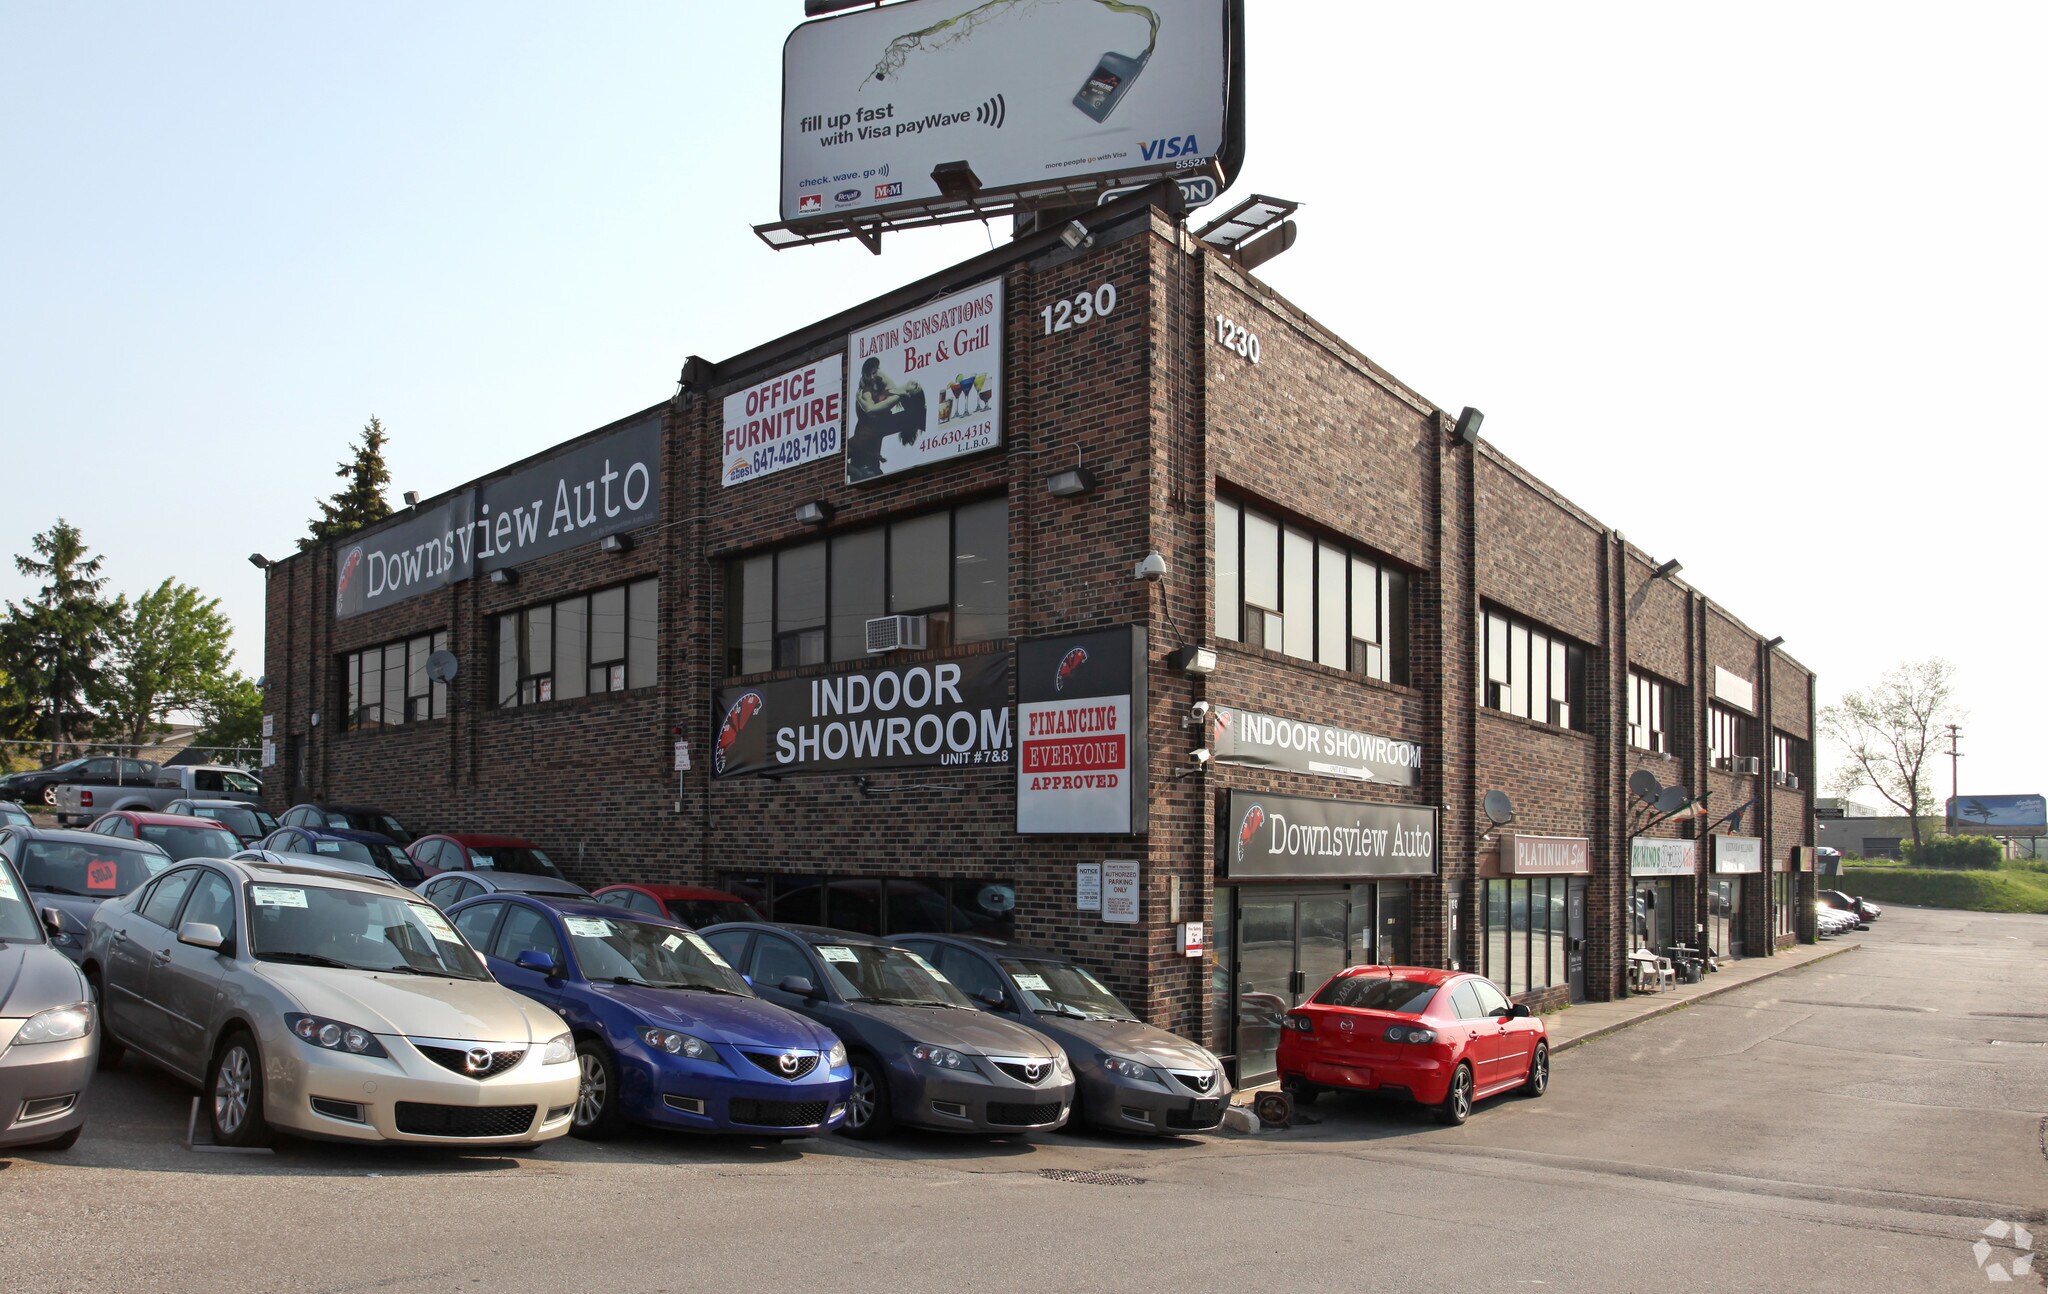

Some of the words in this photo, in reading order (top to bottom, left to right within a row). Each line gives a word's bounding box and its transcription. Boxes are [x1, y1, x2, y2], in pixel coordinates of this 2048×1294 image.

[800, 115, 822, 133] fill
[827, 113, 850, 130] up
[856, 103, 894, 123] fast
[820, 130, 853, 147] with
[857, 126, 891, 141] Visa
[896, 110, 971, 137] payWave
[1045, 161, 1062, 169] more
[1063, 157, 1086, 168] people
[1087, 156, 1096, 164] go
[1097, 153, 1112, 161] with
[1136, 134, 1199, 161] VISA
[1175, 158, 1207, 169] 5552A
[799, 176, 831, 188] check.
[833, 172, 860, 182] wave.
[863, 168, 876, 178] go
[859, 327, 899, 359] LATIN
[903, 293, 993, 344] SENSATIONS
[1040, 283, 1117, 335] 1230
[903, 347, 932, 373] Bar
[935, 339, 950, 363] &
[953, 324, 990, 356] Grill
[1215, 313, 1260, 364] 1230
[745, 368, 816, 417] OFFICE
[725, 393, 839, 456] FURNITURE
[919, 420, 992, 452] 416.630.4318
[753, 426, 837, 474] 647-428-7189
[367, 503, 543, 598] Downsview
[548, 459, 650, 538] Auto
[811, 663, 963, 717] INDOOR
[776, 706, 1013, 764] SHOWROOM
[1029, 705, 1117, 736] FINANCING
[1241, 713, 1321, 753] INDOOR
[1324, 729, 1421, 769] SHOWROOM
[941, 752, 971, 766] UNIT
[1029, 742, 1118, 767] EVERYONE
[1030, 774, 1119, 790] APPROVED
[1268, 813, 1389, 858] Downsview
[1391, 822, 1432, 858] Auto
[1519, 842, 1569, 866] PLATINUM
[1571, 843, 1584, 869] Spa
